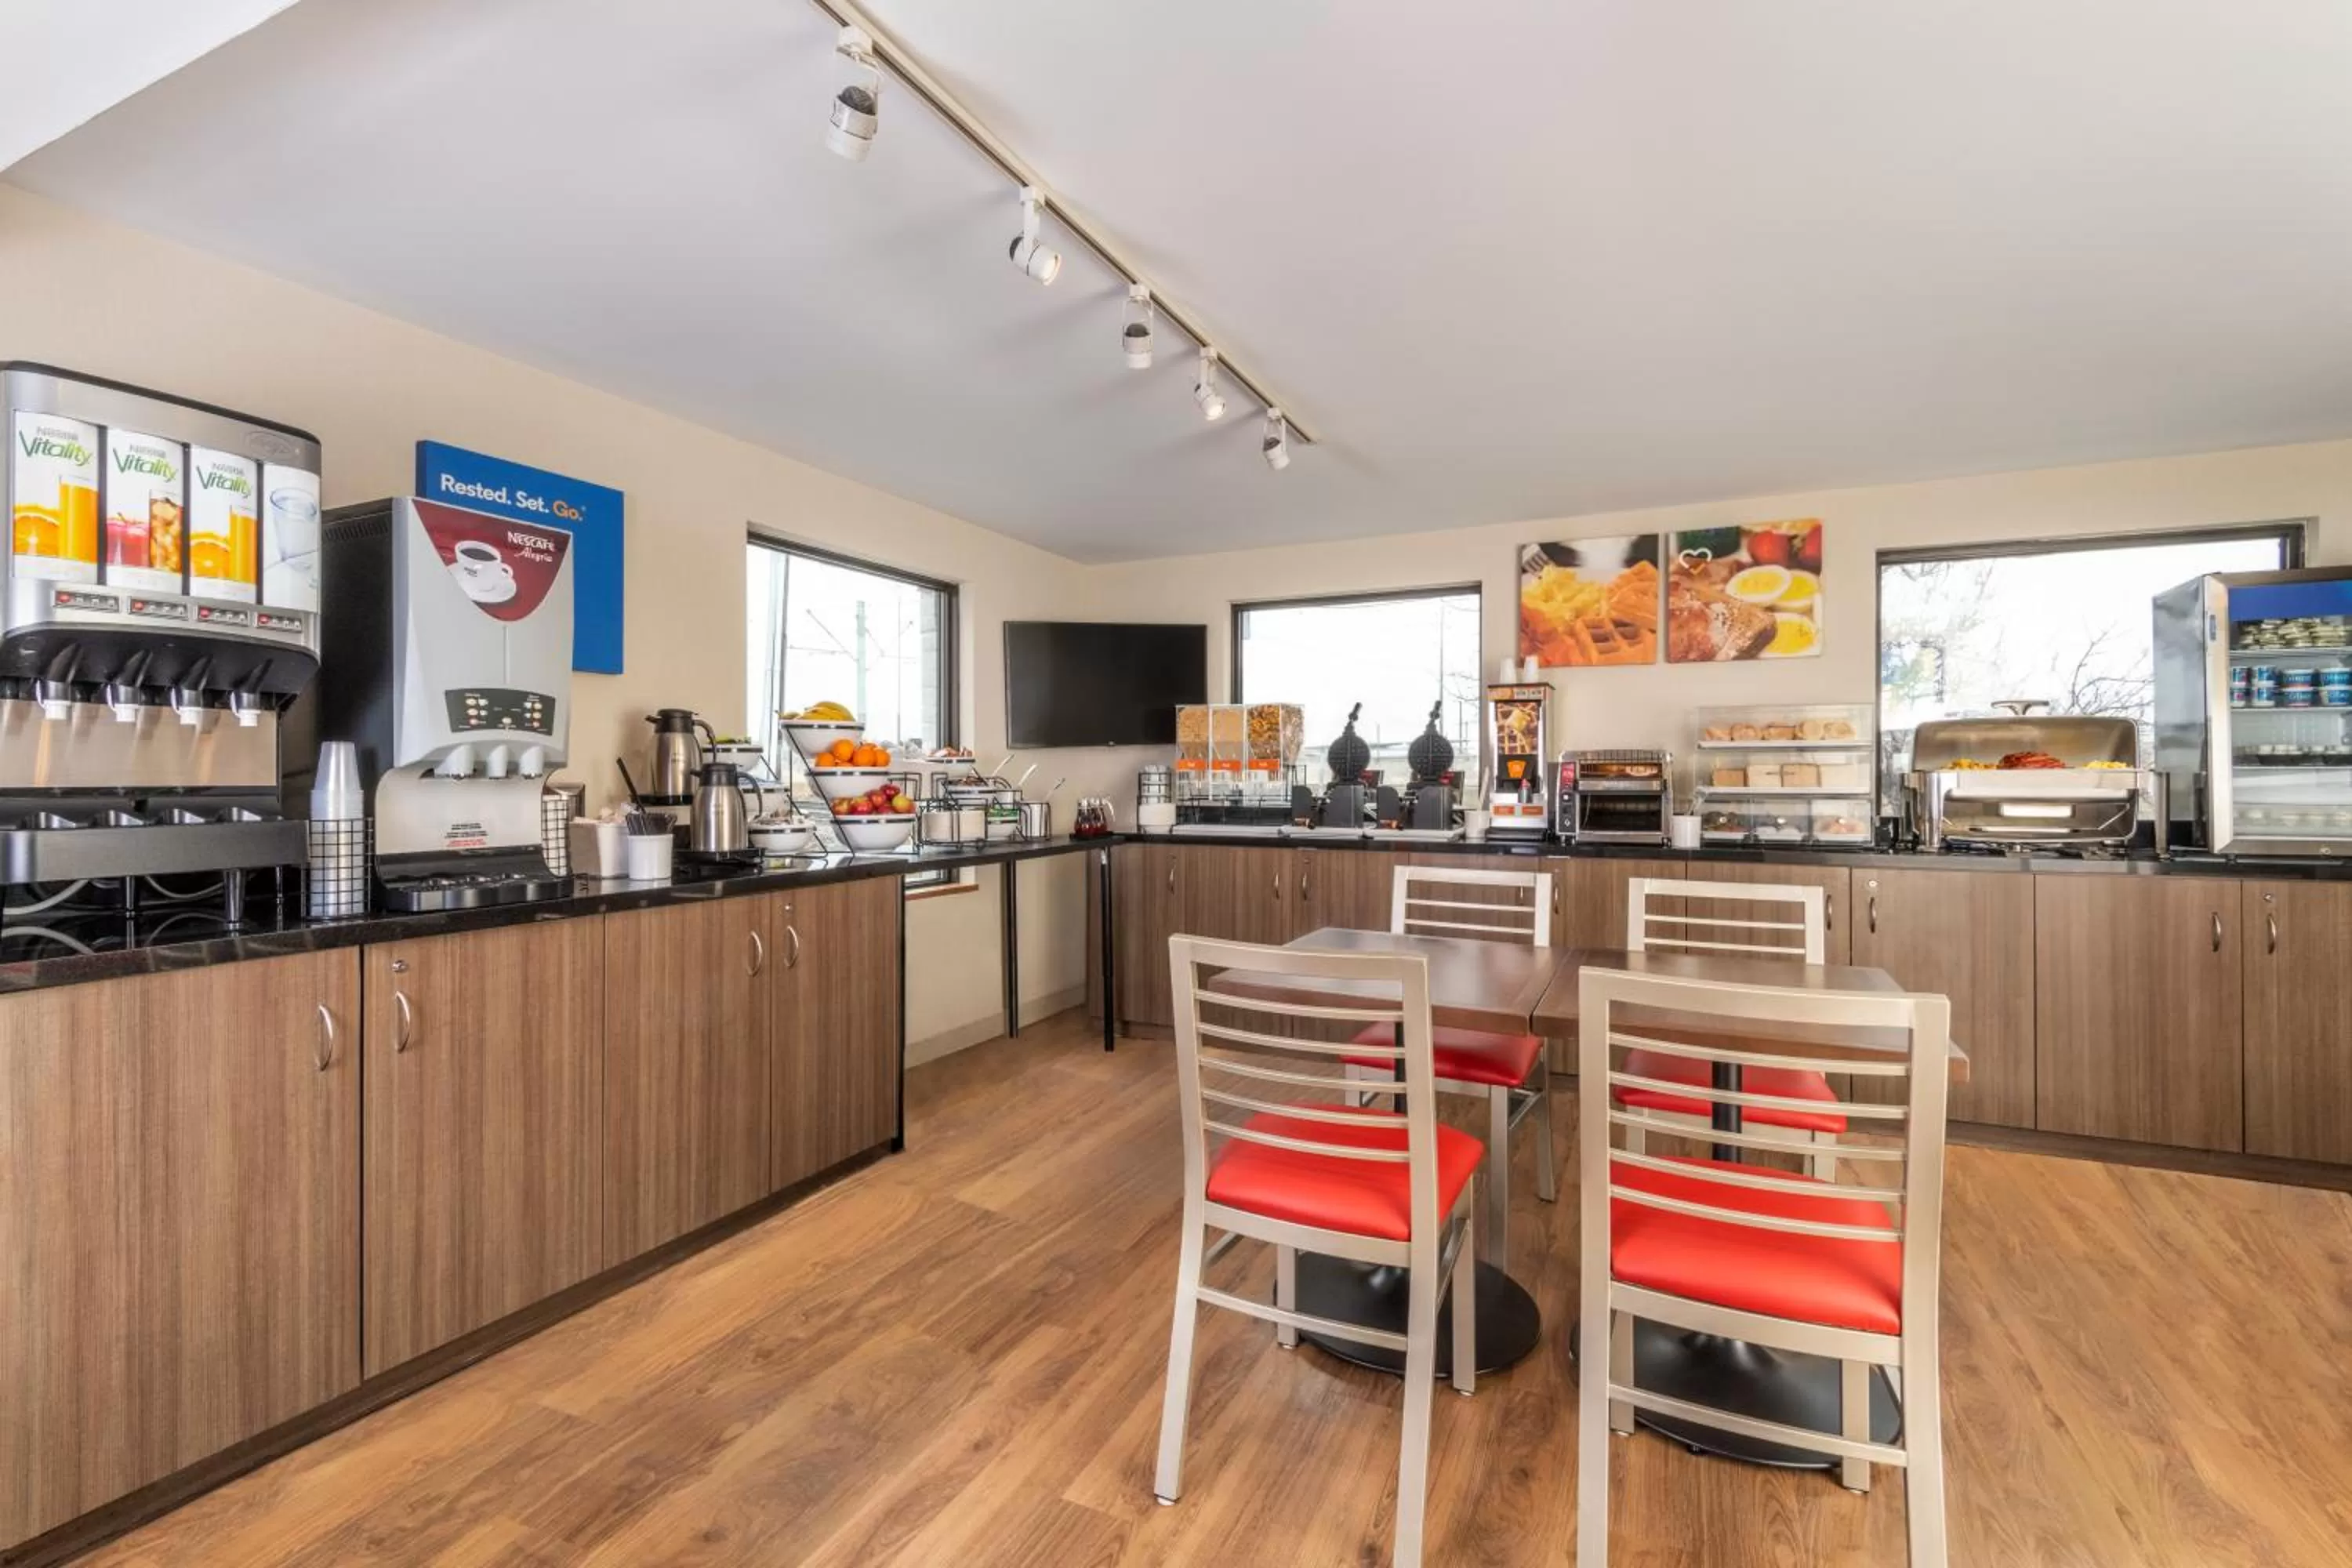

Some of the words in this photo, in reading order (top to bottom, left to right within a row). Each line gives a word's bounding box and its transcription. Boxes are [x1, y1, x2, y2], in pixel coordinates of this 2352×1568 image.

[19, 430, 92, 466] Vitality
[113, 448, 178, 483] Vitality
[197, 465, 251, 499] Vitality
[441, 473, 511, 506] Rested.
[515, 490, 550, 514] Set.
